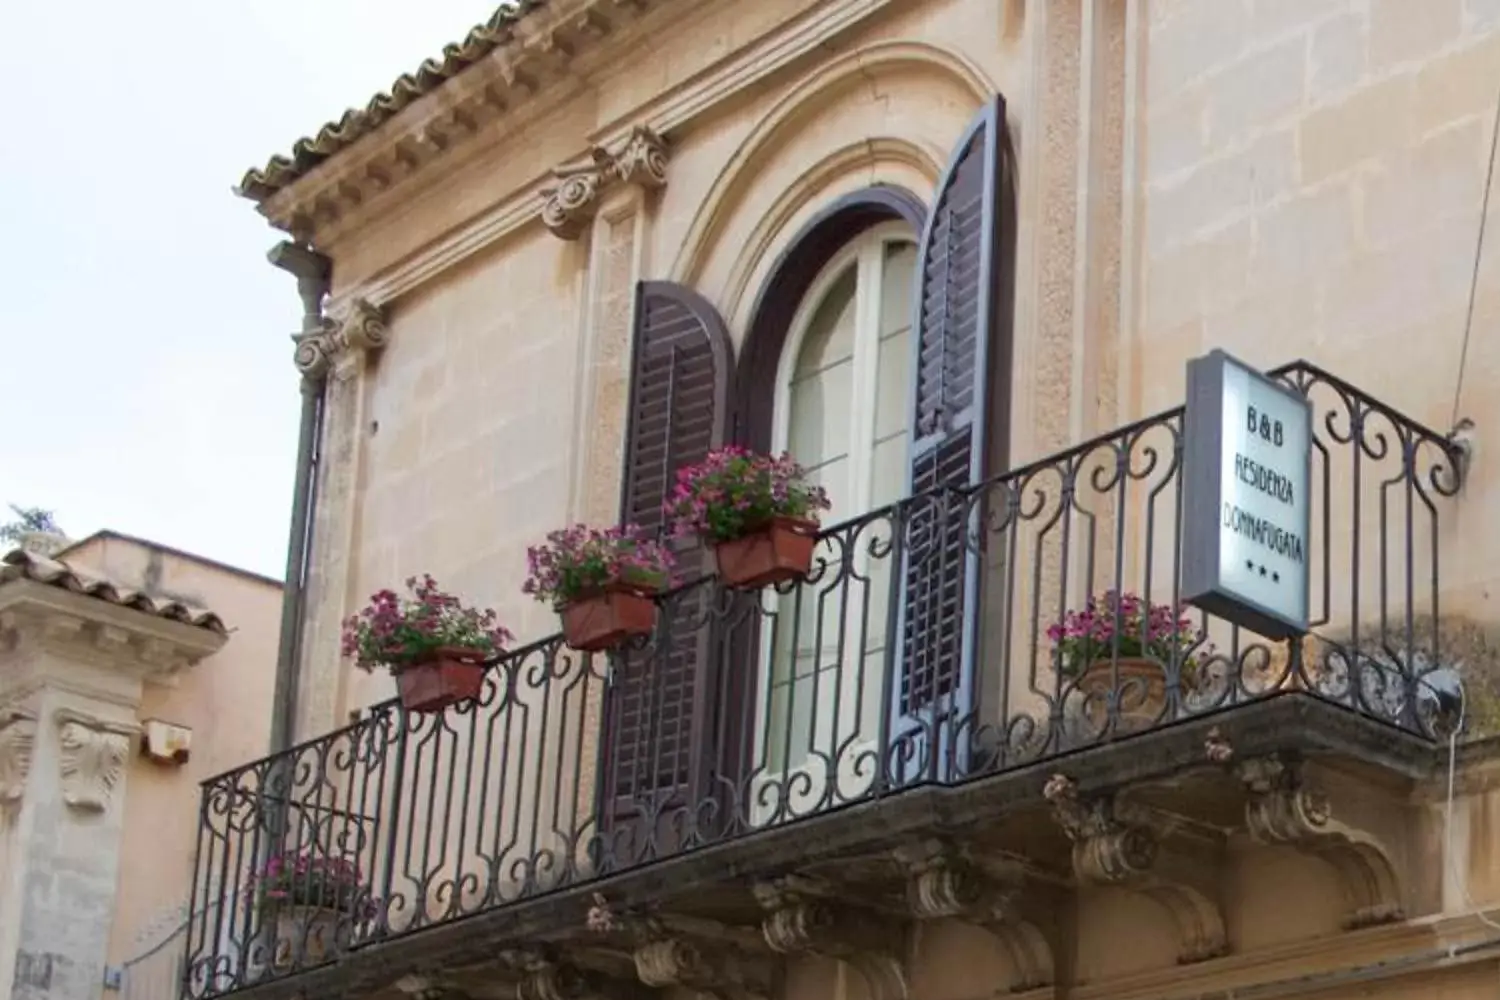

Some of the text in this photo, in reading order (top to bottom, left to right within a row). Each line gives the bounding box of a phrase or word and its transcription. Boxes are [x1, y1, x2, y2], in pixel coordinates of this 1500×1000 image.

[1247, 405, 1284, 448] B&B
[1235, 452, 1294, 505] RESIDENZA
[1223, 502, 1304, 563] DONNAFUGATA
